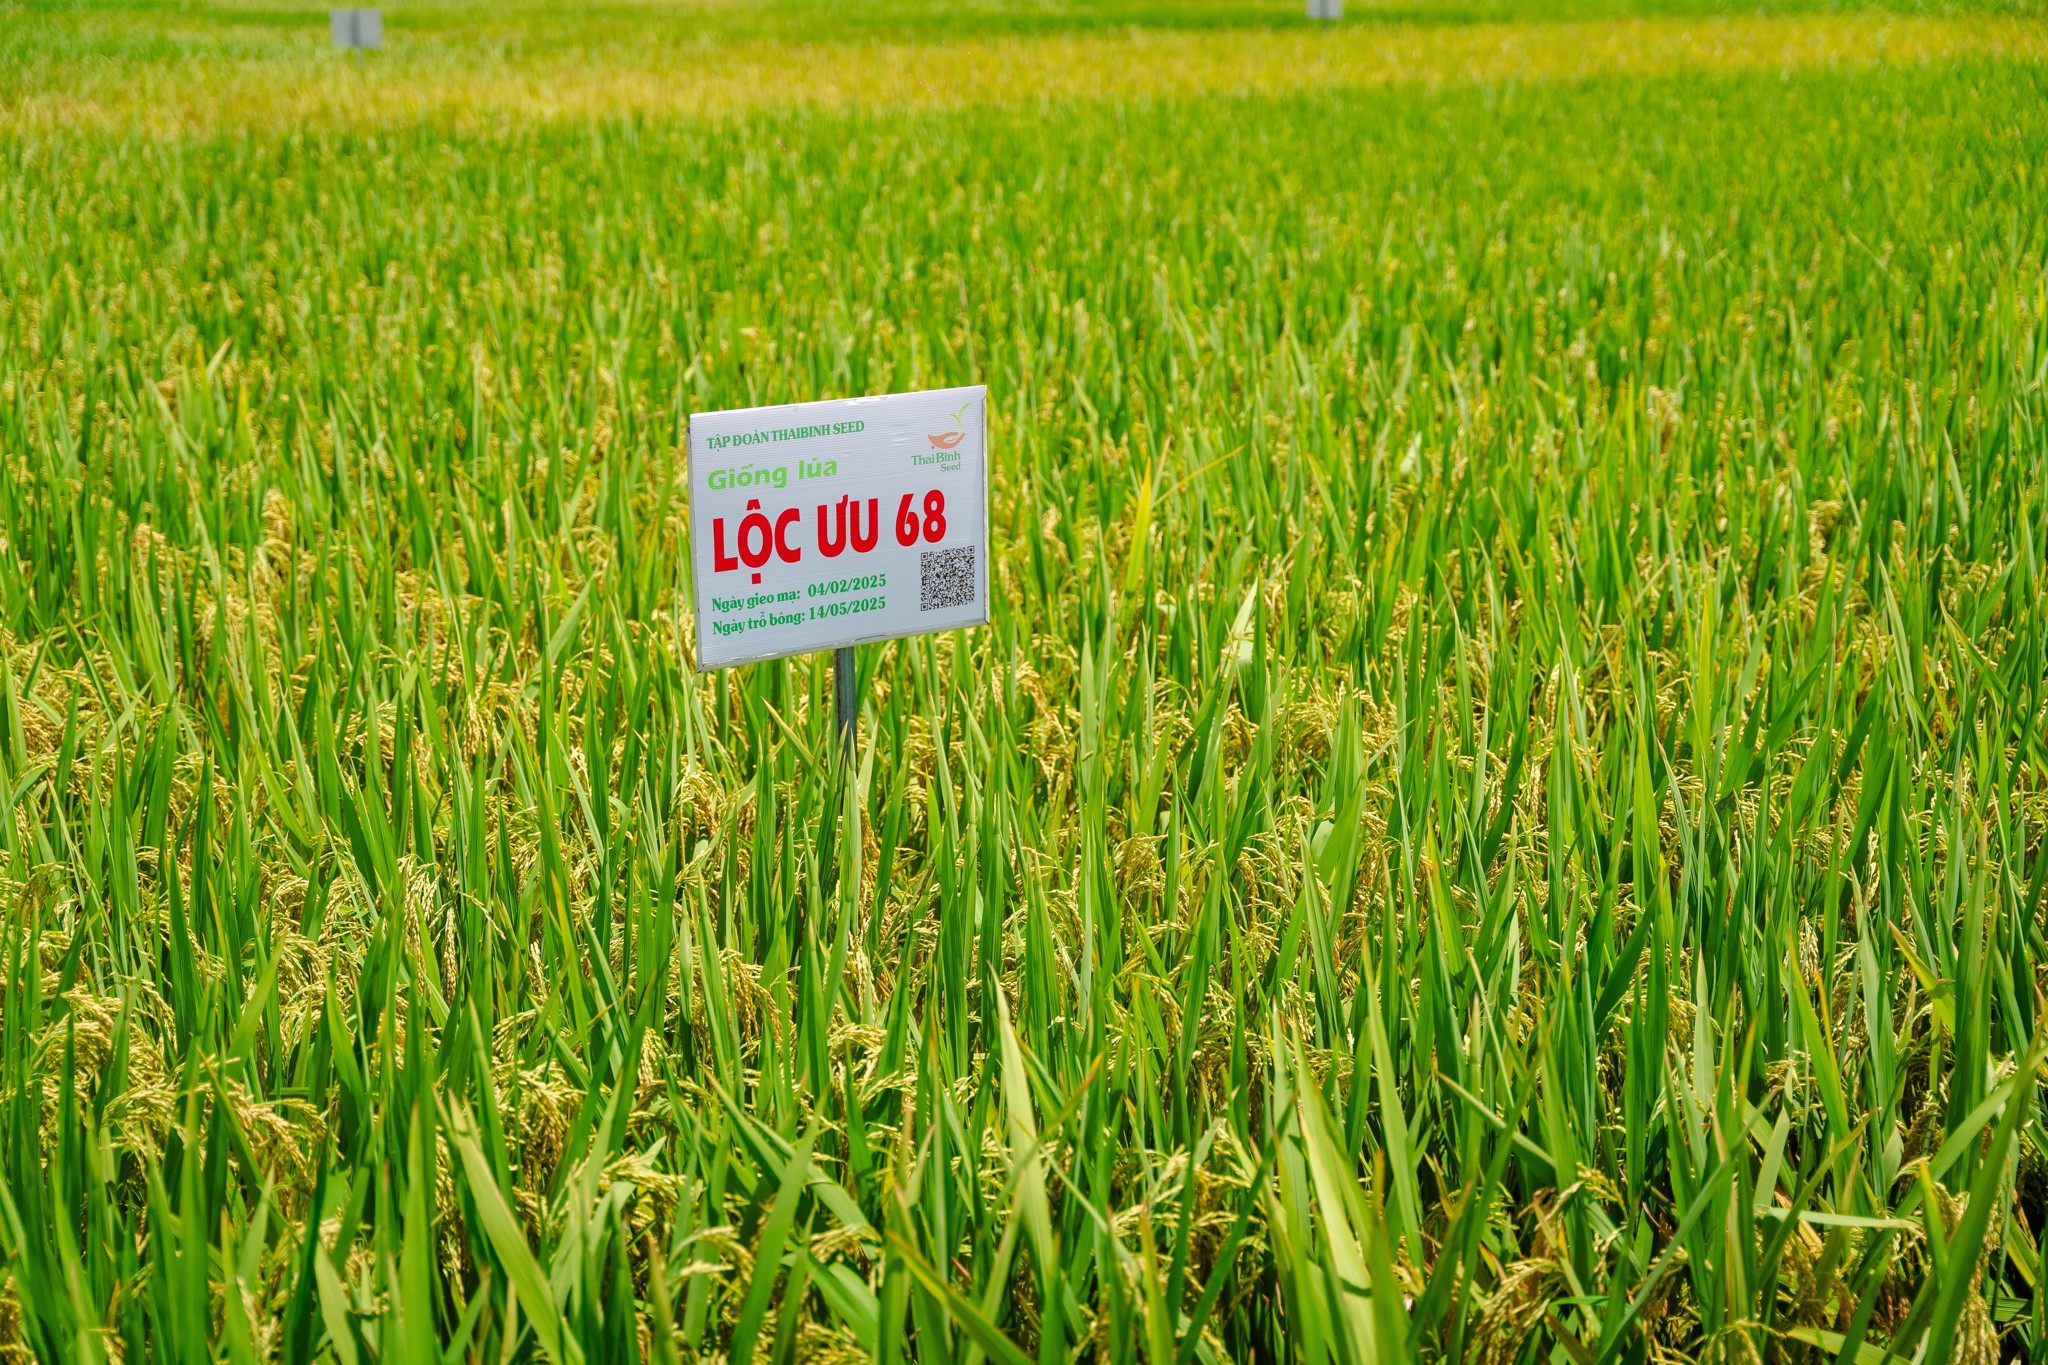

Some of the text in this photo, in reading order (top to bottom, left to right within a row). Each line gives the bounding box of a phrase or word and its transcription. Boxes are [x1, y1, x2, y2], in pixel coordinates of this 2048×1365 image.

[707, 420, 865, 452] TẬP ĐOÀN THAIBINH SEED
[707, 457, 837, 490] Giống lúa
[940, 461, 961, 472] Seed
[713, 489, 947, 585] LỘC ƯU 68
[712, 573, 886, 612] Ngày gieo mạ: 04/02/2025
[712, 619, 745, 636] Ngày
[769, 612, 805, 626] bông:
[809, 596, 886, 620] 14/05/2025
